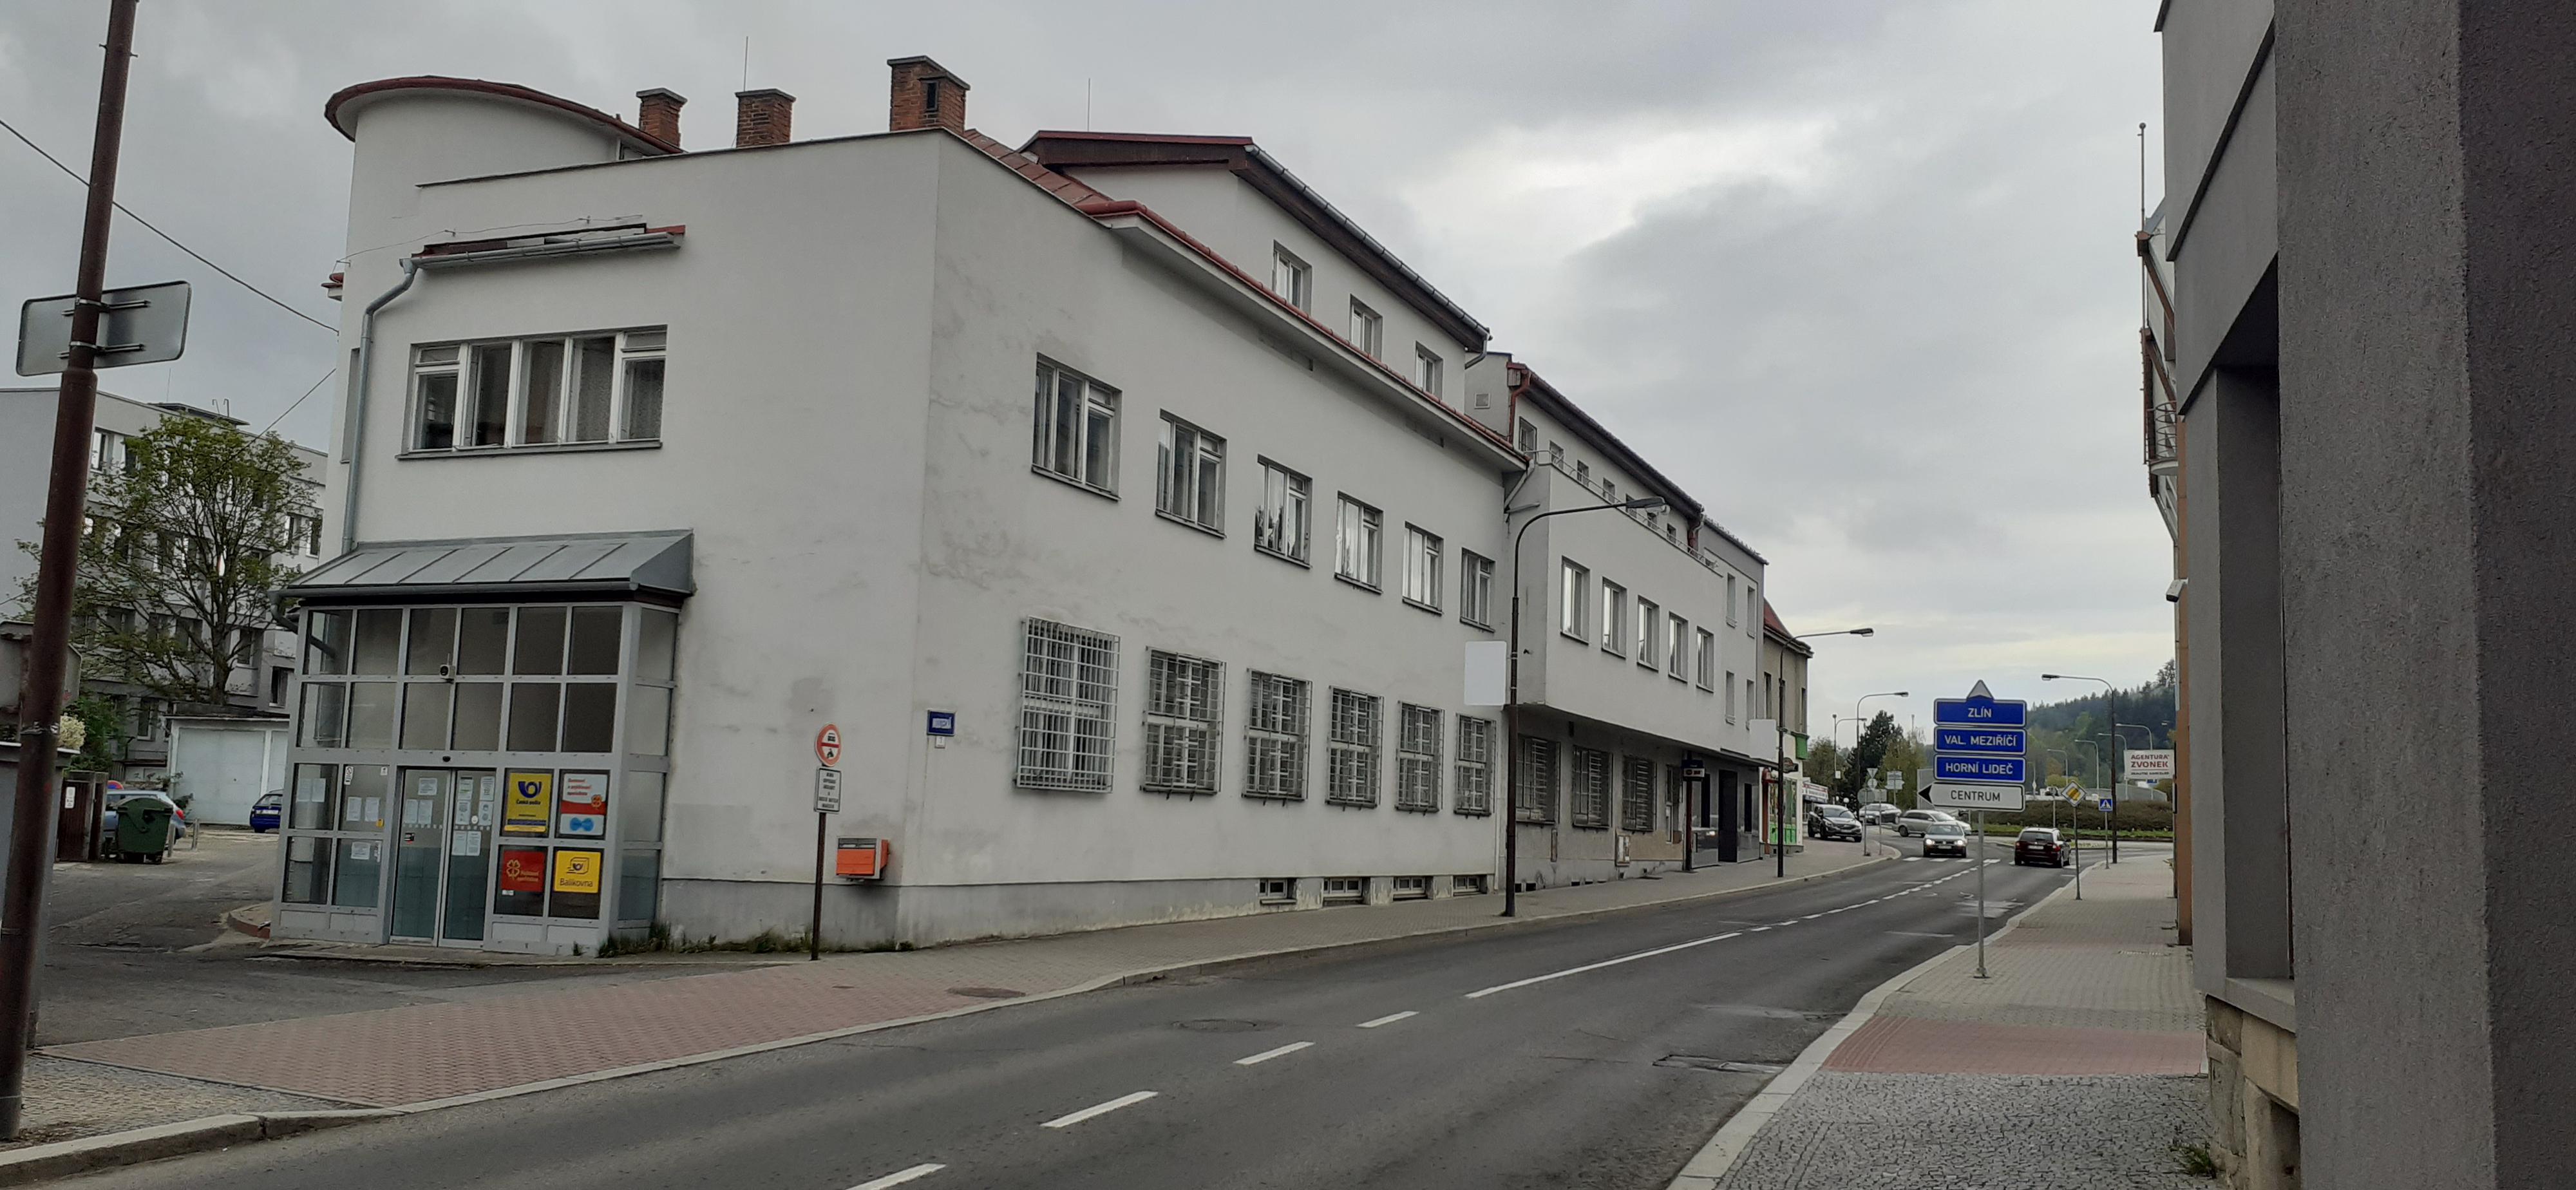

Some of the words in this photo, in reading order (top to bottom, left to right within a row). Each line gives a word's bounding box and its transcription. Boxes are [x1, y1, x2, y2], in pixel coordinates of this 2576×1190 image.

[1967, 706, 1992, 718] ZLÍN
[1944, 735, 1966, 745] VAL.
[1970, 734, 2017, 746] MEZIŘÍČÍ
[1946, 762, 1979, 773] HORNÍ
[1982, 762, 2014, 775] LIDEČ
[1950, 790, 2001, 802] CENTRUM
